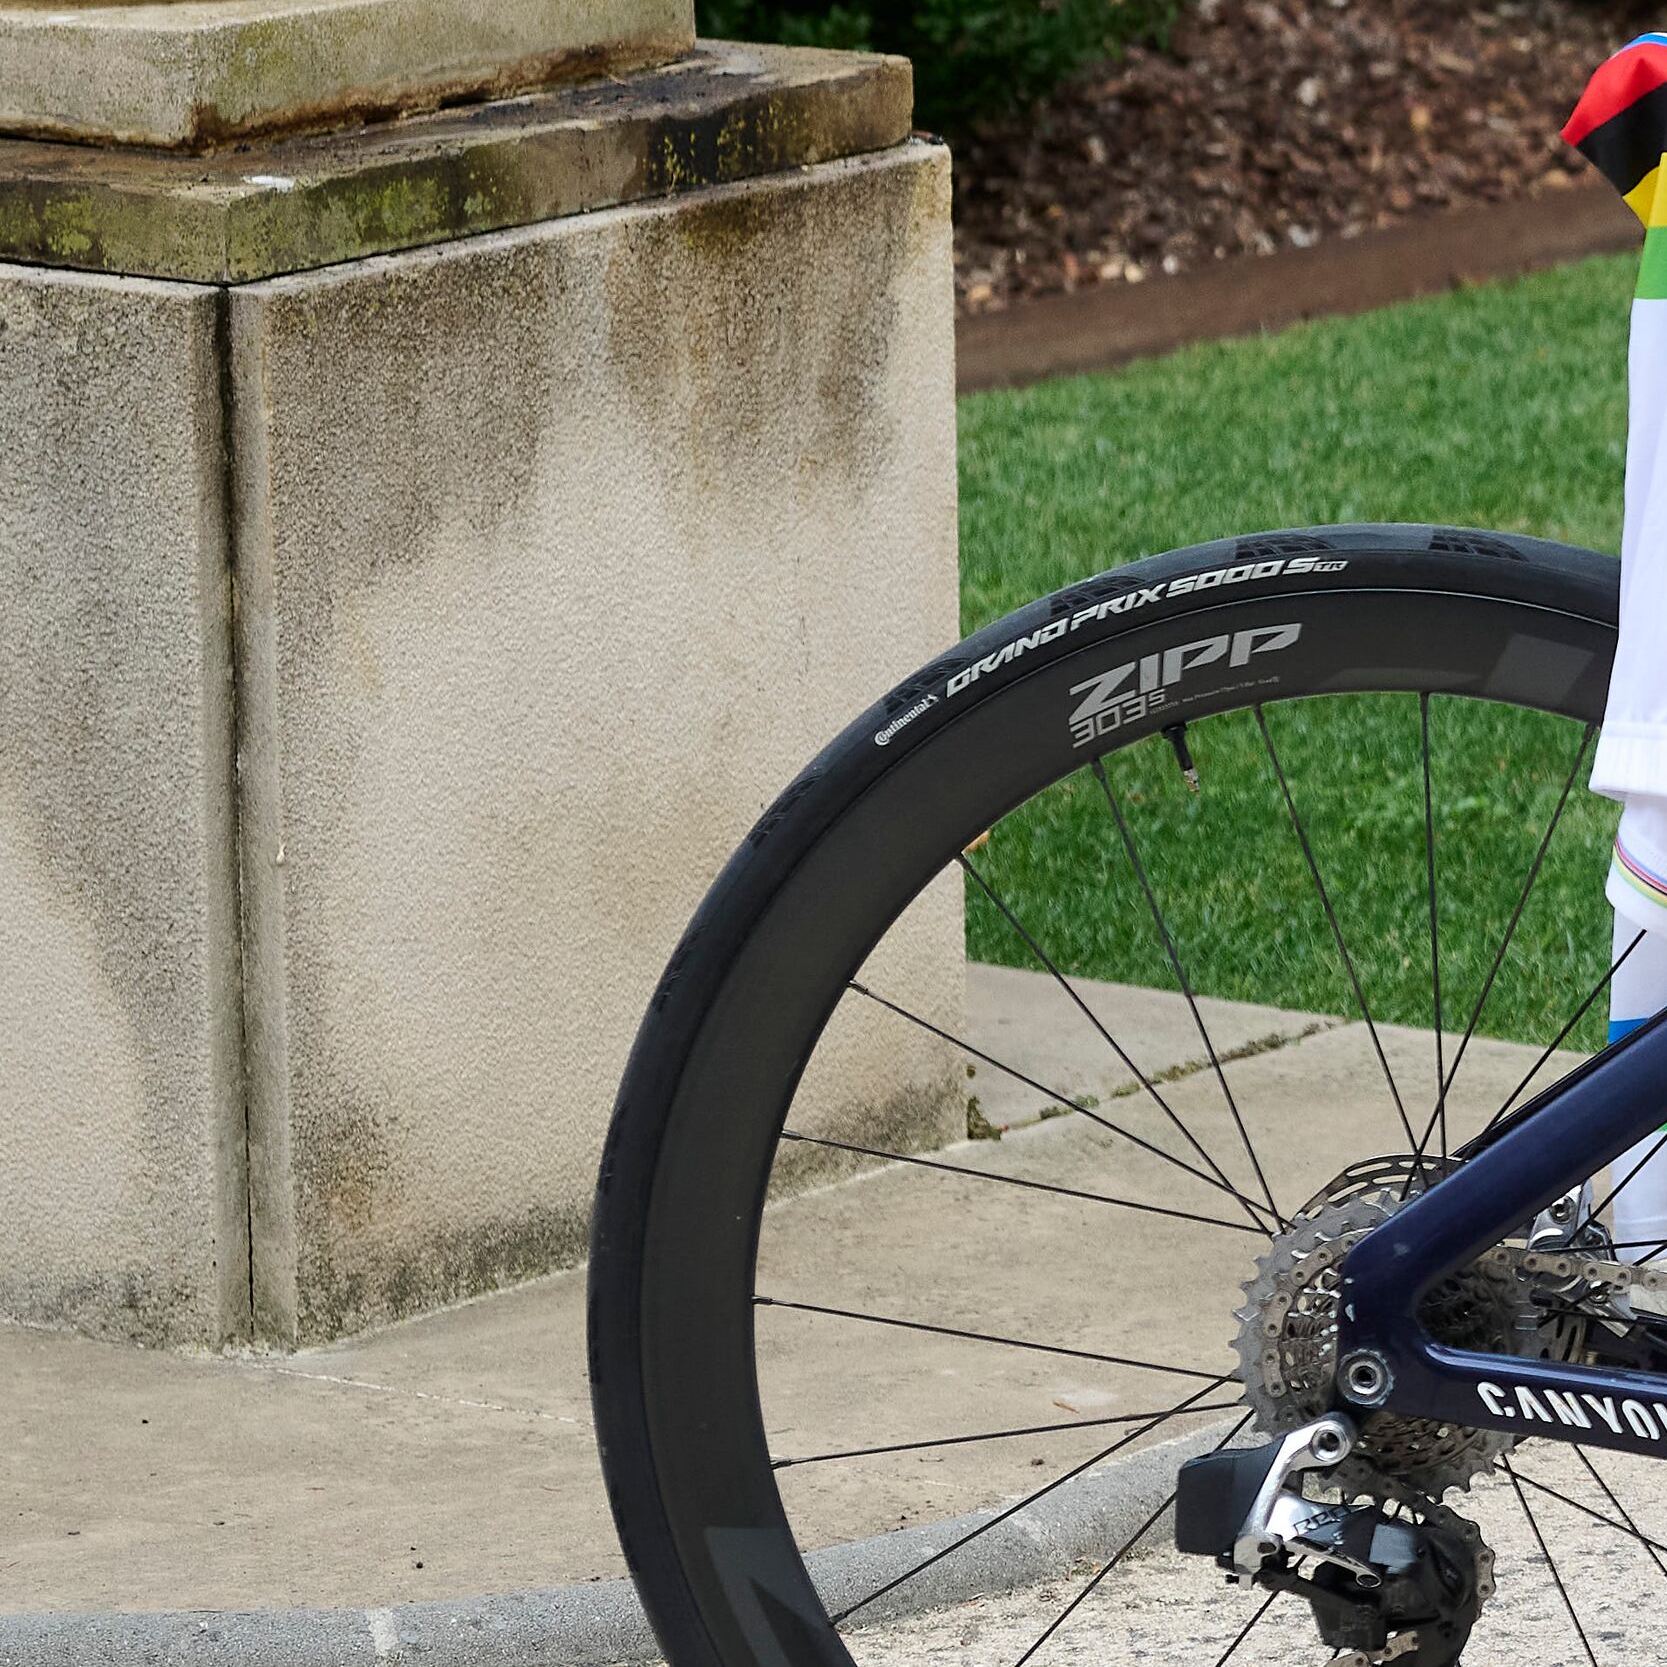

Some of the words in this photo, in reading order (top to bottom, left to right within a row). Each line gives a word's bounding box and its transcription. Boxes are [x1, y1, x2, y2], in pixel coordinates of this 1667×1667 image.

[946, 617, 1071, 698] GRAND
[1070, 584, 1168, 632] PRIX
[1165, 560, 1279, 599] 5000
[1069, 623, 1302, 725] ZIPP
